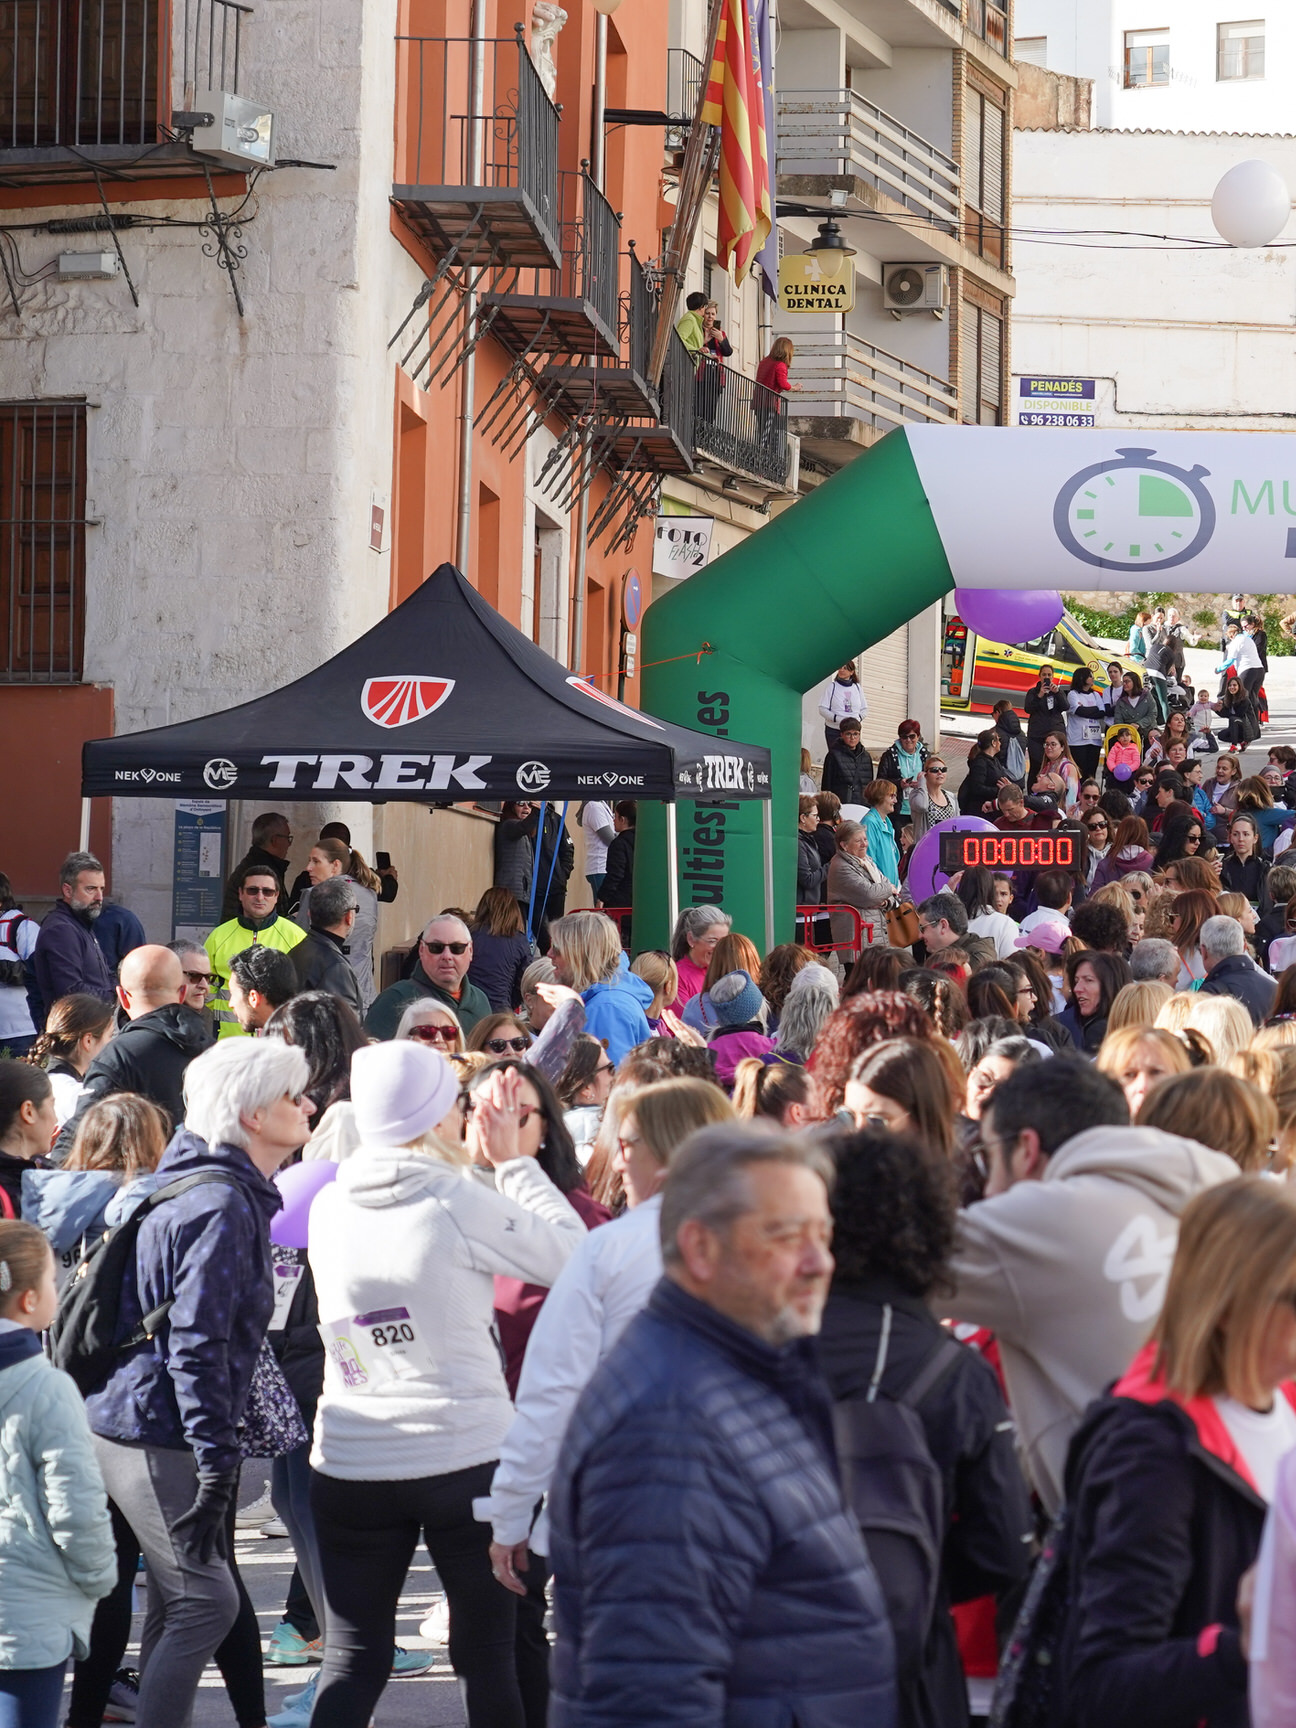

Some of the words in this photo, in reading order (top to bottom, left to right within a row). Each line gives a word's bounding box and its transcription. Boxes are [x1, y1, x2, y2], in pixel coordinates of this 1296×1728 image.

[784, 284, 846, 295] CLINICA
[787, 298, 843, 309] DENTAL
[1030, 380, 1083, 393] PENADÉS
[1024, 399, 1092, 412] DISPONIBLE
[1030, 414, 1044, 426] 96
[1045, 415, 1065, 426] 238
[1066, 415, 1080, 427] 06
[1080, 416, 1093, 427] 33
[657, 526, 708, 546] FOTO
[692, 552, 704, 566] 2
[260, 754, 493, 790] TREK
[703, 755, 745, 790] TREK
[963, 837, 1073, 866] 00:00:00
[371, 1323, 415, 1348] 820
